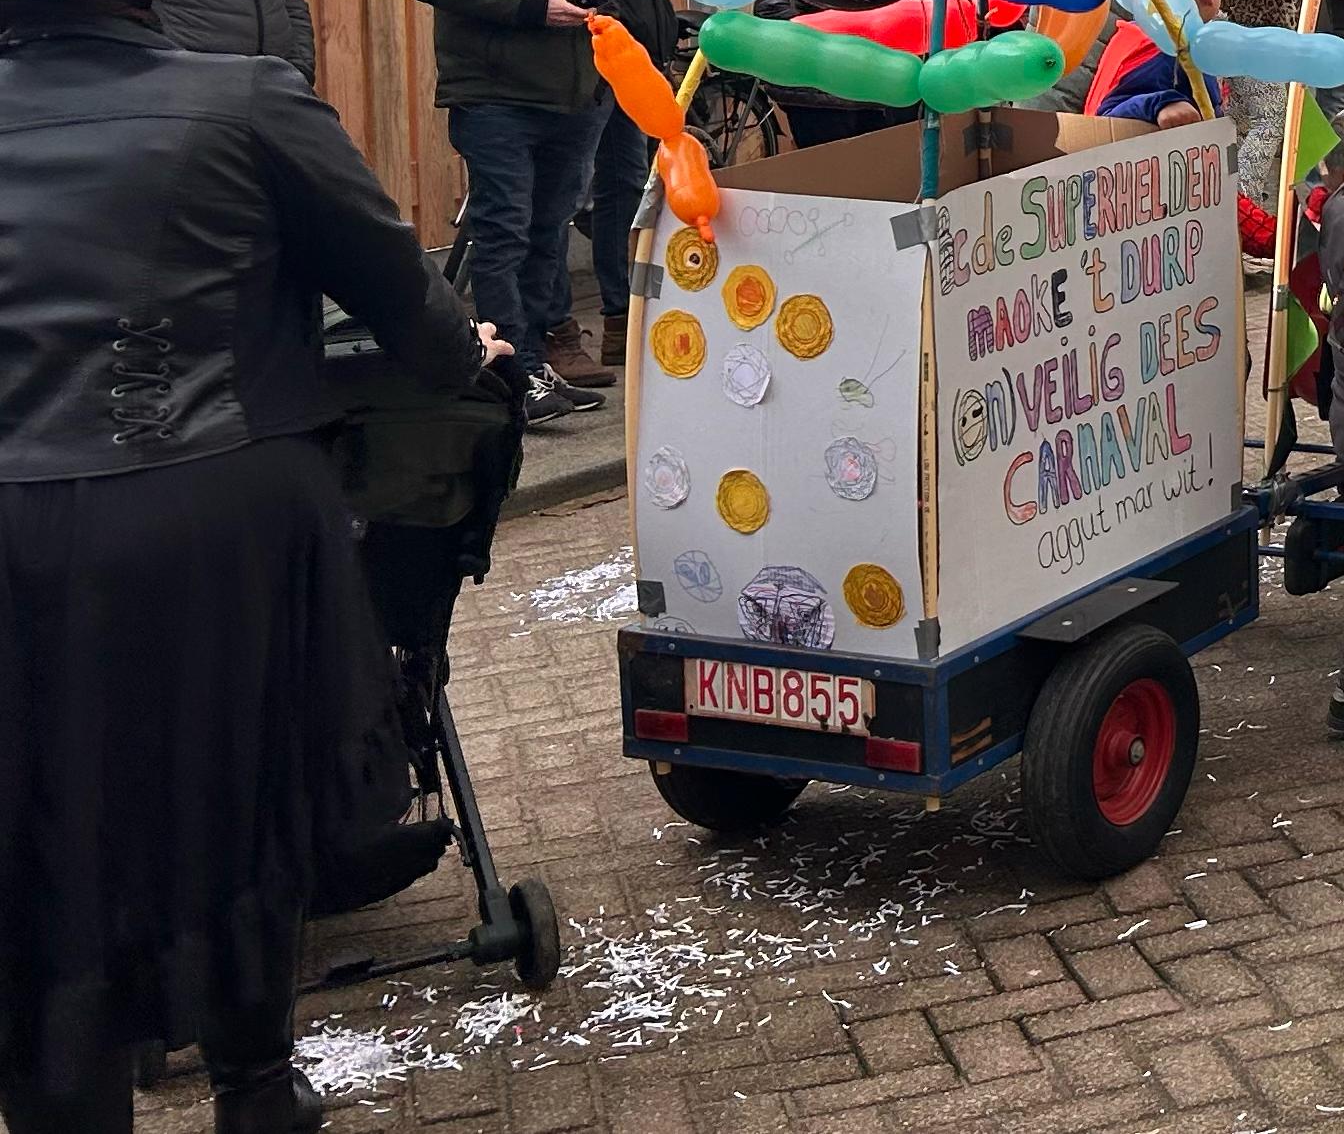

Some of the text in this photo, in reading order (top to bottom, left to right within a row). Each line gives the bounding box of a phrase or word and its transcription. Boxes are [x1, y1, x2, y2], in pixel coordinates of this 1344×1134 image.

[1120, 219, 1204, 305] DURP
[1139, 296, 1222, 384] DEES
[1115, 481, 1154, 524] mar
[699, 660, 860, 727] KNB855
